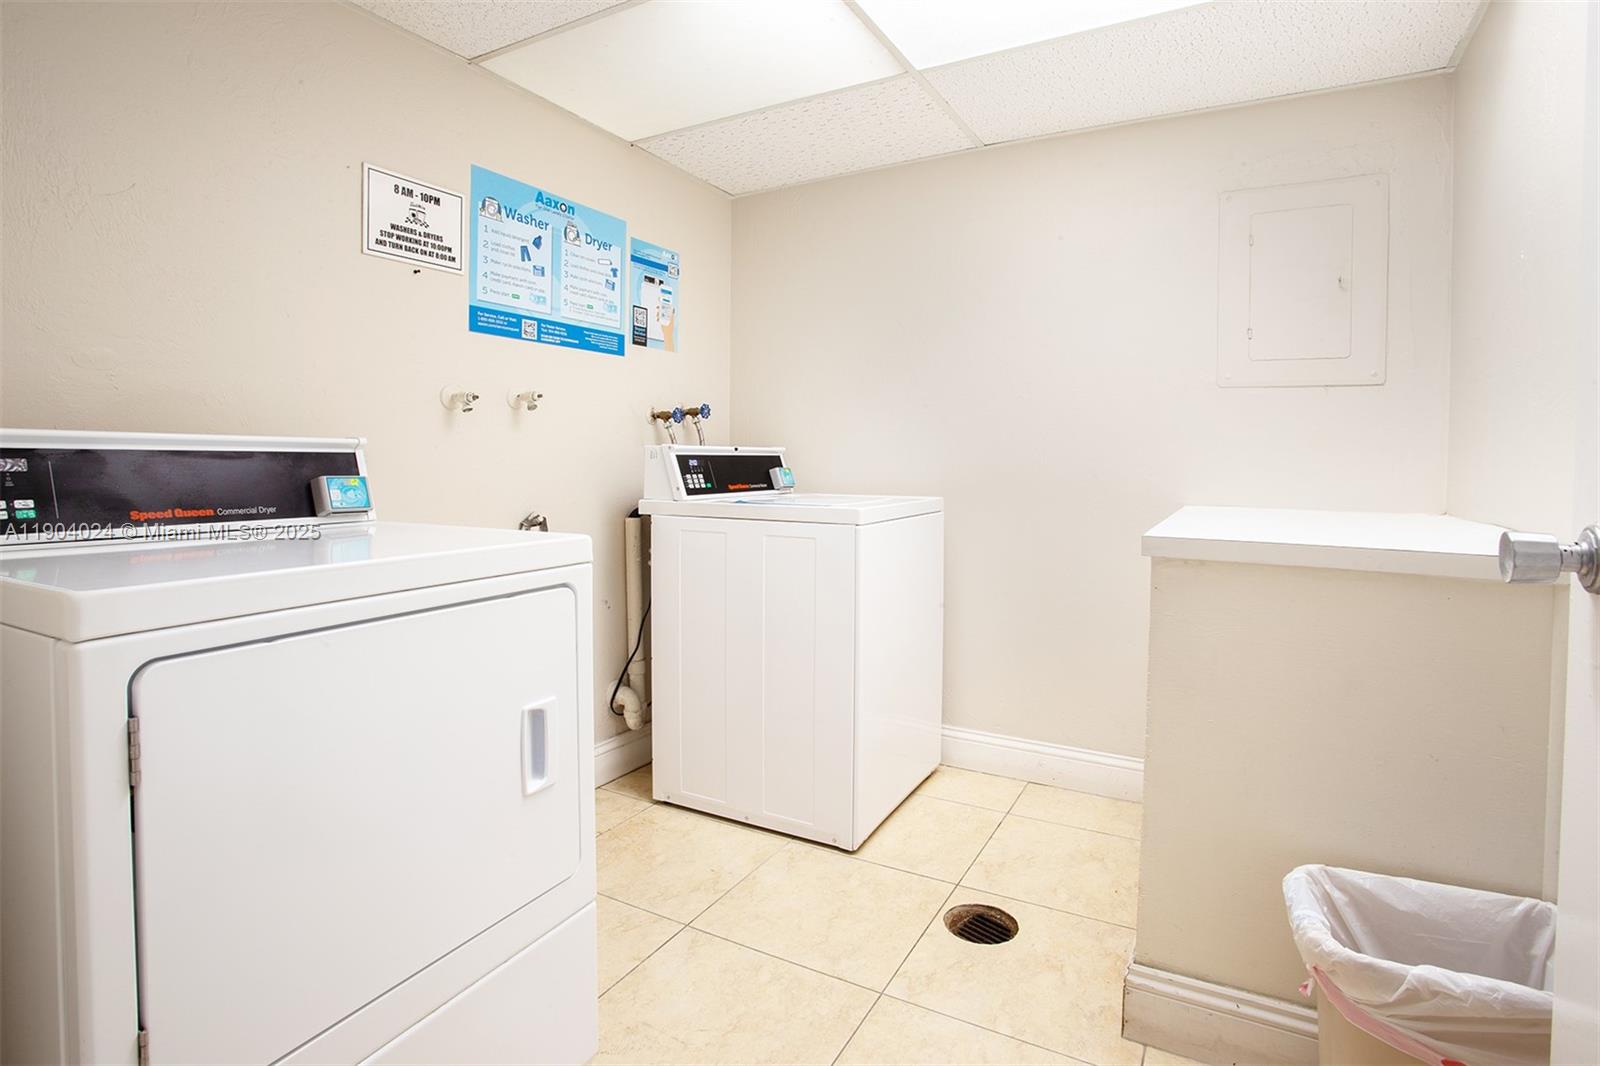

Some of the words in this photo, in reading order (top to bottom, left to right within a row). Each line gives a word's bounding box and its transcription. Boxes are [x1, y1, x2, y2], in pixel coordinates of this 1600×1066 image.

[394, 184, 400, 194] 8
[401, 187, 414, 199] AM
[420, 193, 441, 206] 10PM
[535, 191, 575, 215] Aaxon
[504, 205, 548, 230] Washer
[390, 223, 417, 236] WASHERS
[423, 232, 444, 243] DRYERS
[483, 225, 489, 234] 1
[380, 229, 394, 239] STOP
[395, 234, 422, 246] WORKING
[423, 240, 430, 248] AT
[482, 240, 489, 249] 2
[585, 233, 612, 251] Dryer
[375, 238, 388, 247] AND
[388, 241, 403, 251] TURN
[404, 245, 419, 255] BACK
[420, 248, 428, 257] ON
[428, 250, 435, 258] AT
[448, 255, 457, 263] AM
[482, 256, 489, 264] 3
[564, 259, 569, 267] 2
[564, 270, 569, 278] 3
[482, 286, 488, 294] 5
[563, 298, 569, 306] 5
[130, 509, 172, 521] Speed
[174, 507, 214, 518] Queen
[216, 506, 256, 517] Commercial
[258, 505, 277, 516] Dryer
